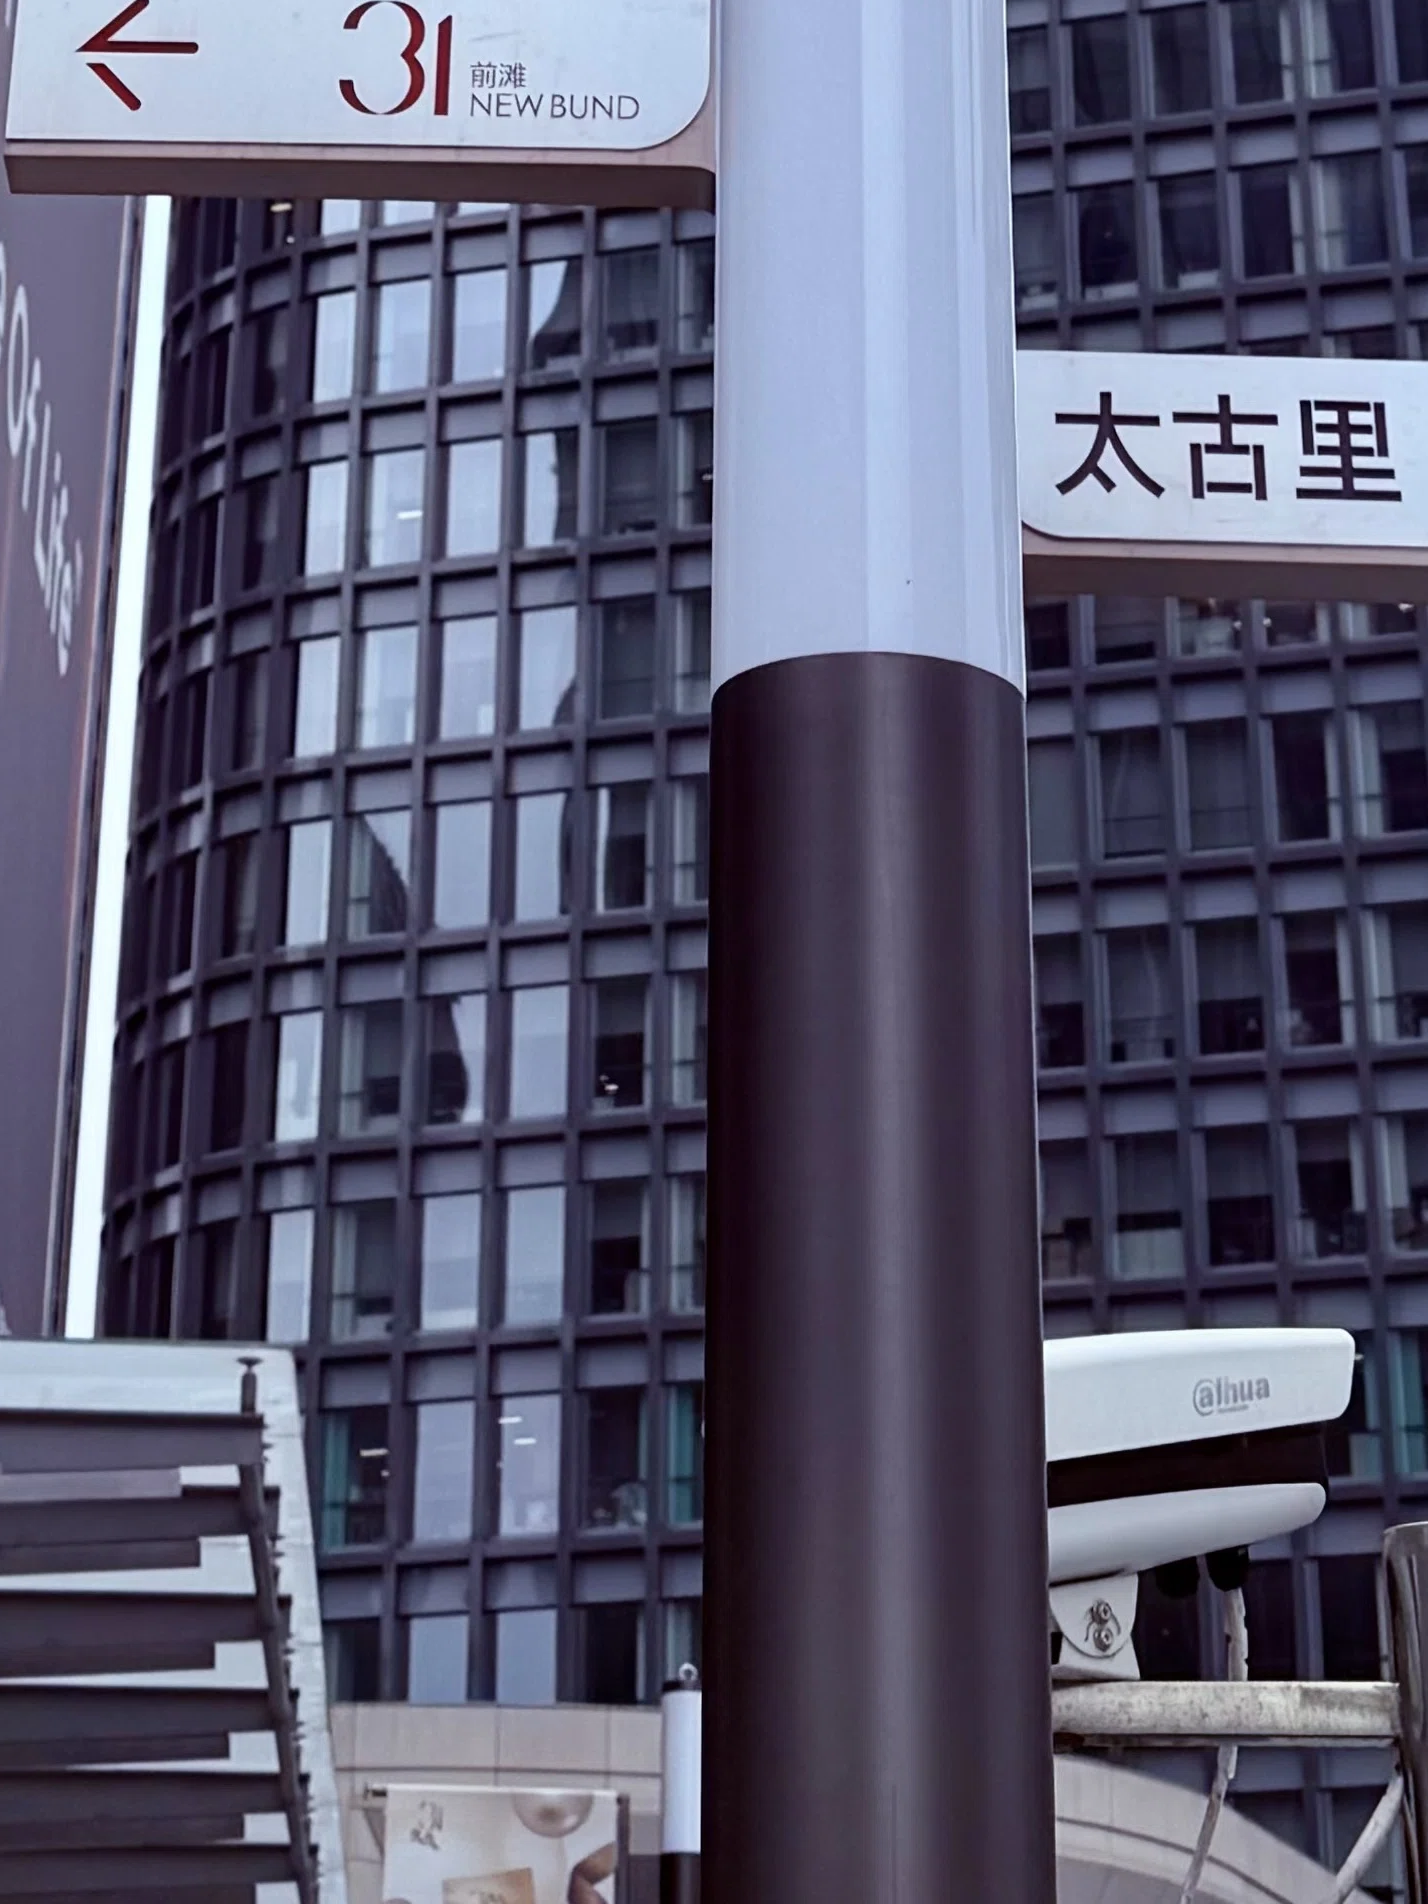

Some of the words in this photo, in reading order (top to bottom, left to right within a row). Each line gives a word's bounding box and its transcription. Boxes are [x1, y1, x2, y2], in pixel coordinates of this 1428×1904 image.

[339, 0, 453, 116] 31
[469, 93, 543, 118] NEW
[550, 94, 640, 120] BUND
[470, 61, 526, 89] 前滩
[6, 284, 41, 513] Of
[1055, 391, 1402, 502] 太古里
